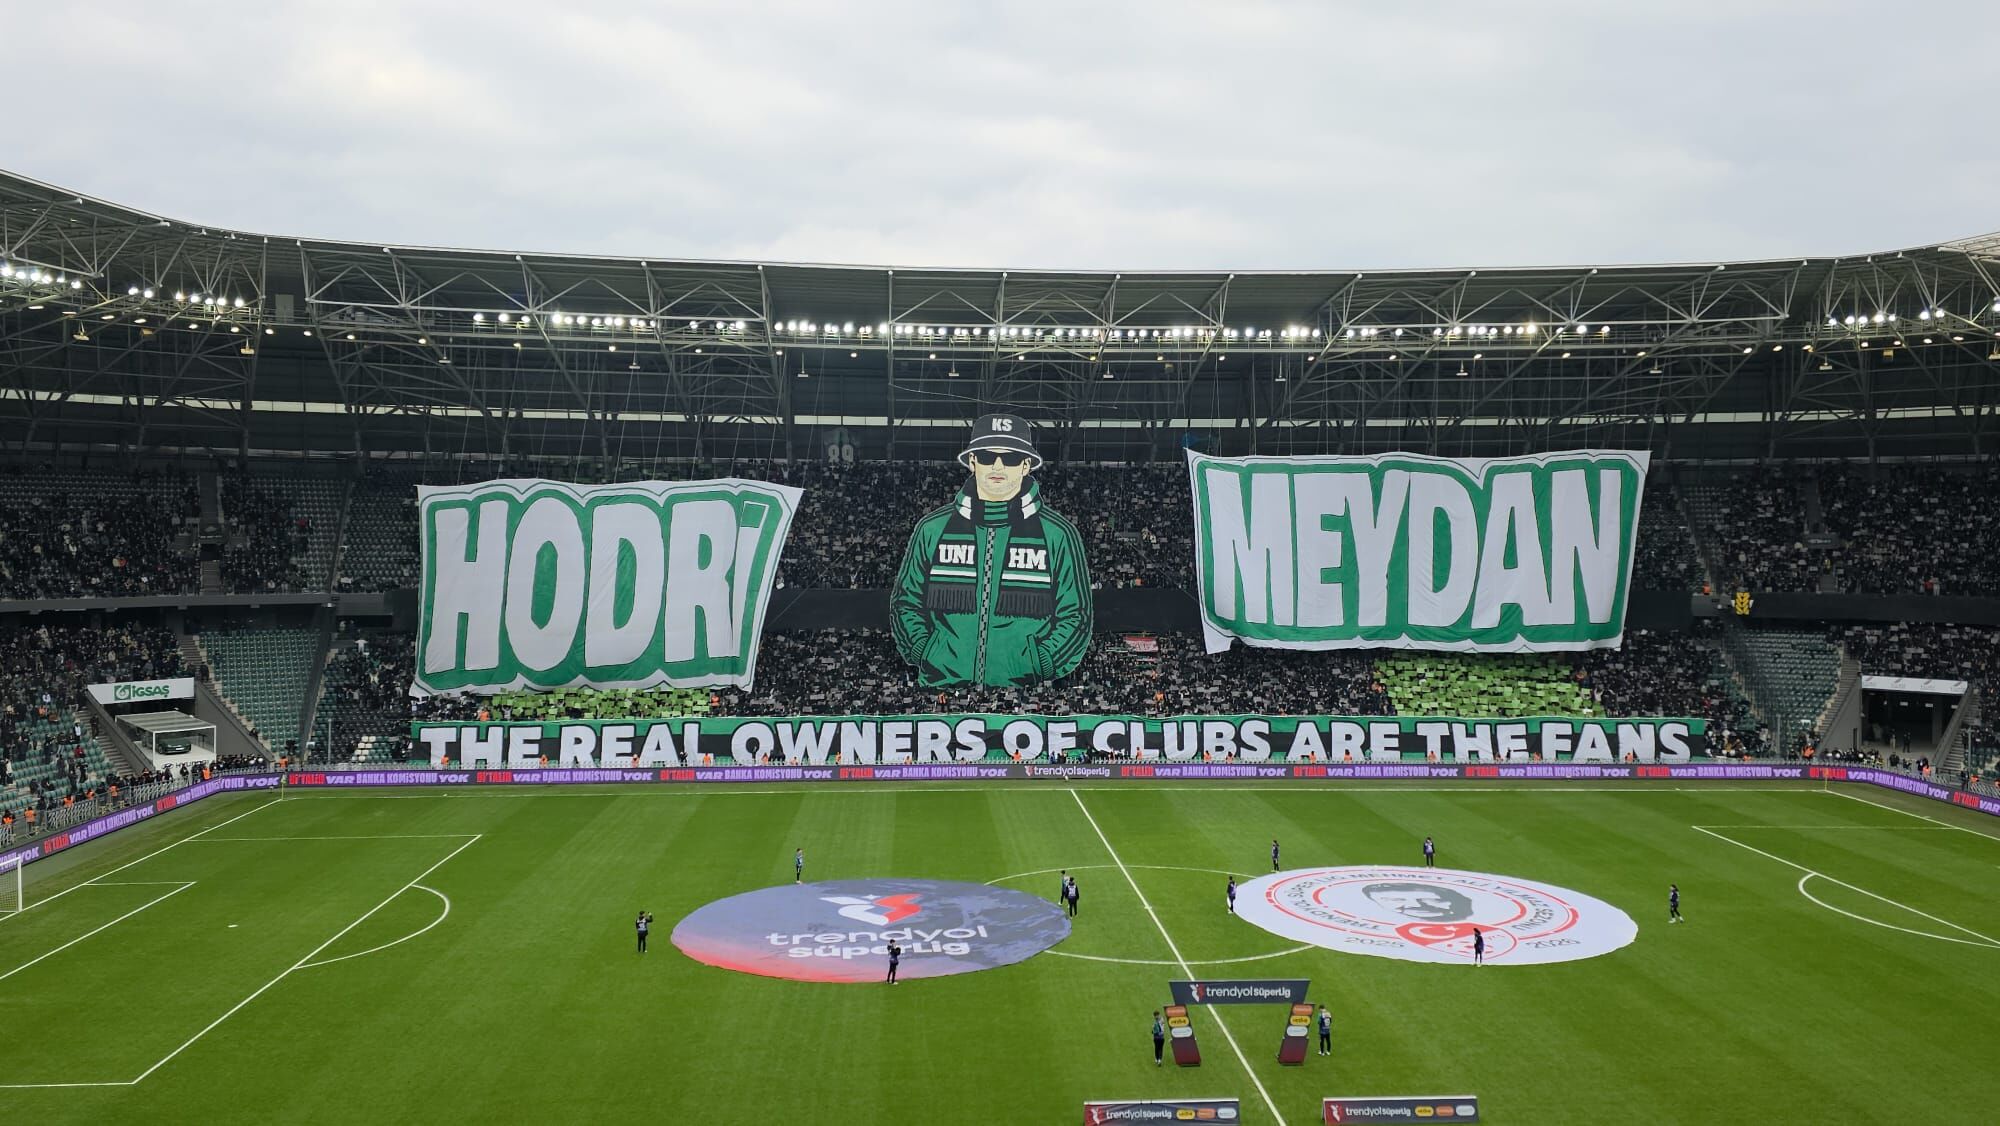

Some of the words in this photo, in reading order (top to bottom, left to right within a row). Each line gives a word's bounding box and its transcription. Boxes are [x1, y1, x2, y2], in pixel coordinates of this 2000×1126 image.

[992, 418, 1012, 431] KS
[1205, 468, 1622, 630] MEYDAN
[938, 544, 975, 565] UNI
[1008, 547, 1047, 570] HM
[132, 685, 170, 698] İGSAŞ
[420, 726, 543, 767] THE
[560, 723, 714, 767] REAL
[731, 718, 987, 765] OWNERS
[1003, 720, 1077, 763] OF
[1093, 719, 1272, 762] CLUBS
[1288, 721, 1399, 763] ARE
[1416, 722, 1529, 763] THE
[1541, 721, 1691, 763] FANS
[513, 774, 542, 782] VAR
[623, 772, 652, 780] YOK
[1258, 768, 1286, 776] YOK
[1773, 769, 1802, 777] YOK
[326, 776, 354, 784] VAR
[1848, 771, 1874, 782] VAR
[1928, 787, 1948, 800] YOK
[176, 792, 192, 805] VAR
[246, 776, 279, 786] YOK
[1979, 799, 2000, 813] VAR
[69, 831, 87, 844] VAR
[137, 805, 154, 819] YOK
[19, 847, 39, 860] YOK
[766, 925, 988, 946] trendyol
